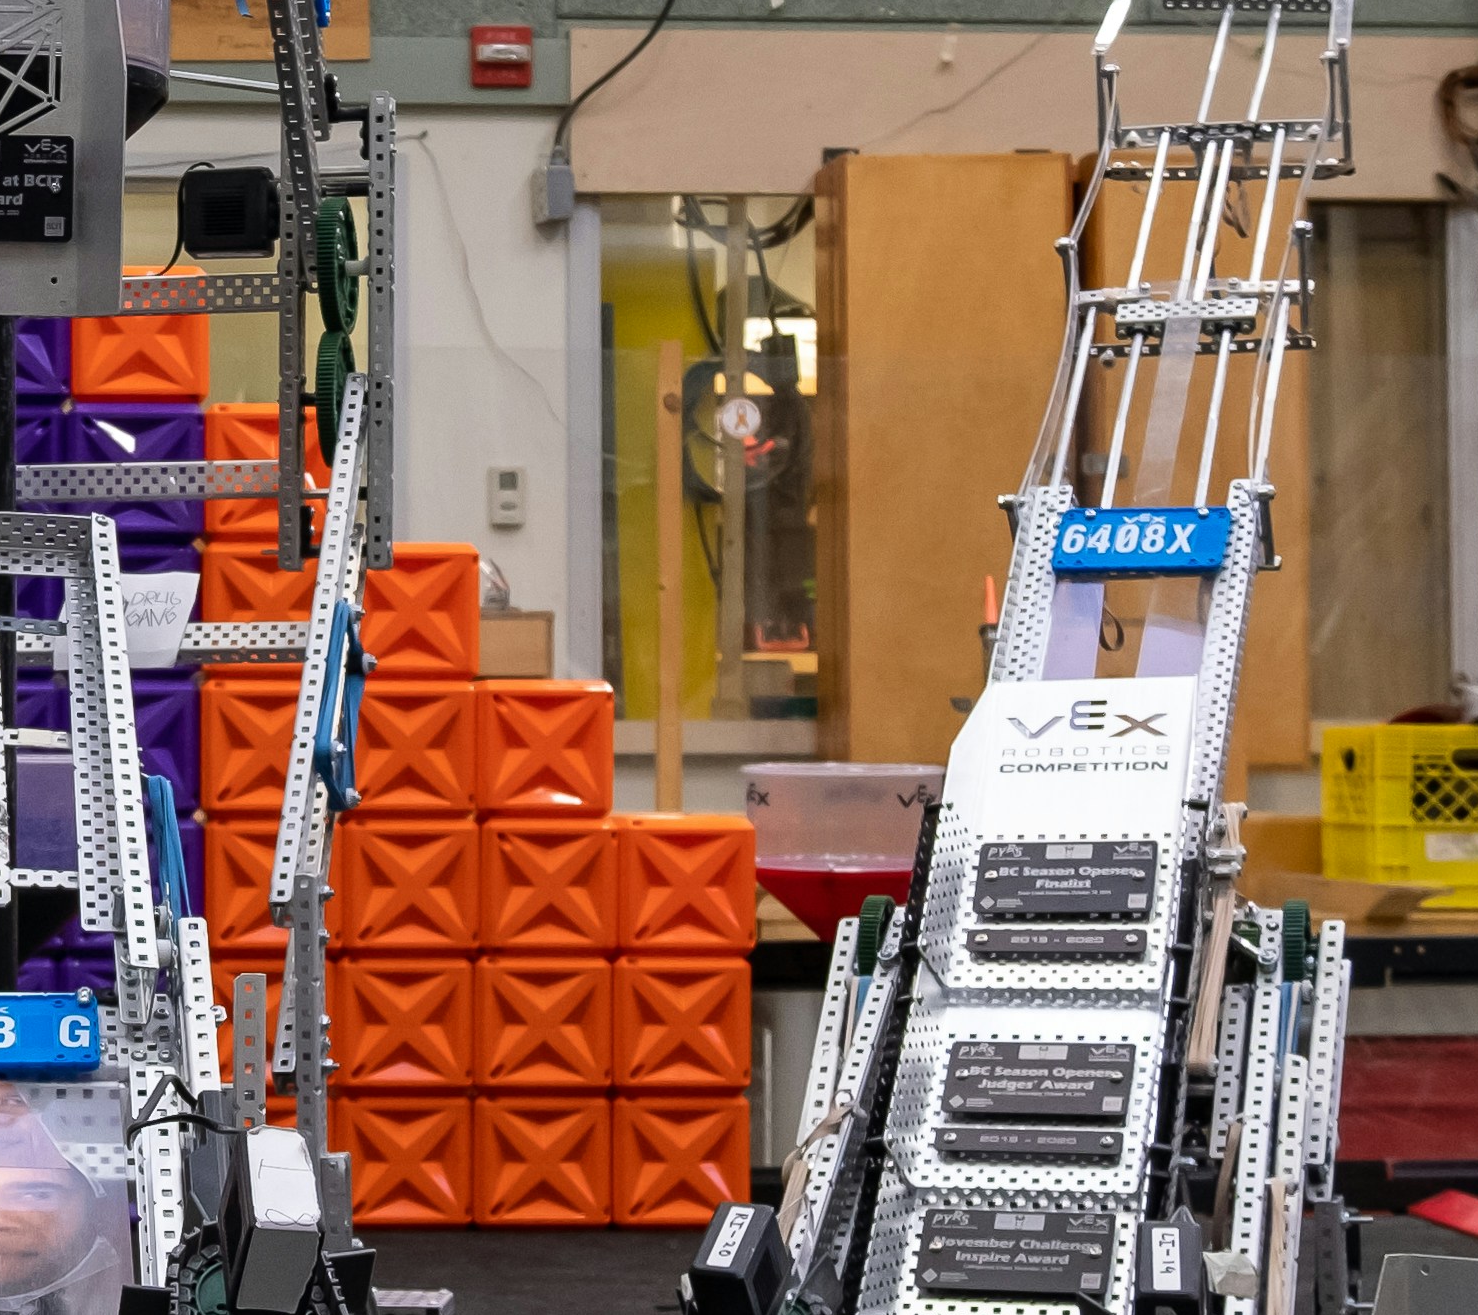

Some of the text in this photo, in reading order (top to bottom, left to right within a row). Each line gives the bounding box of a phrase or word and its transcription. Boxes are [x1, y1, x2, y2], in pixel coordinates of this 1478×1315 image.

[24, 138, 67, 154] VEX
[2, 174, 20, 187] at
[1061, 523, 1198, 554] 6408X
[1006, 700, 1169, 739] VEX
[1001, 746, 1171, 758] ROBOTICS
[999, 762, 1169, 773] COMPETITION
[1114, 842, 1152, 854] VEX
[999, 867, 1075, 876] BC Season
[1035, 879, 1092, 889] Finalist
[59, 1015, 92, 1048] G
[968, 1066, 991, 1076] BC
[994, 1066, 1049, 1077] Season
[978, 1079, 1095, 1091] Judges' Award
[933, 1211, 970, 1225] PYRS
[1068, 1215, 1110, 1227] VEX
[955, 1251, 1070, 1265] Inspire Award
